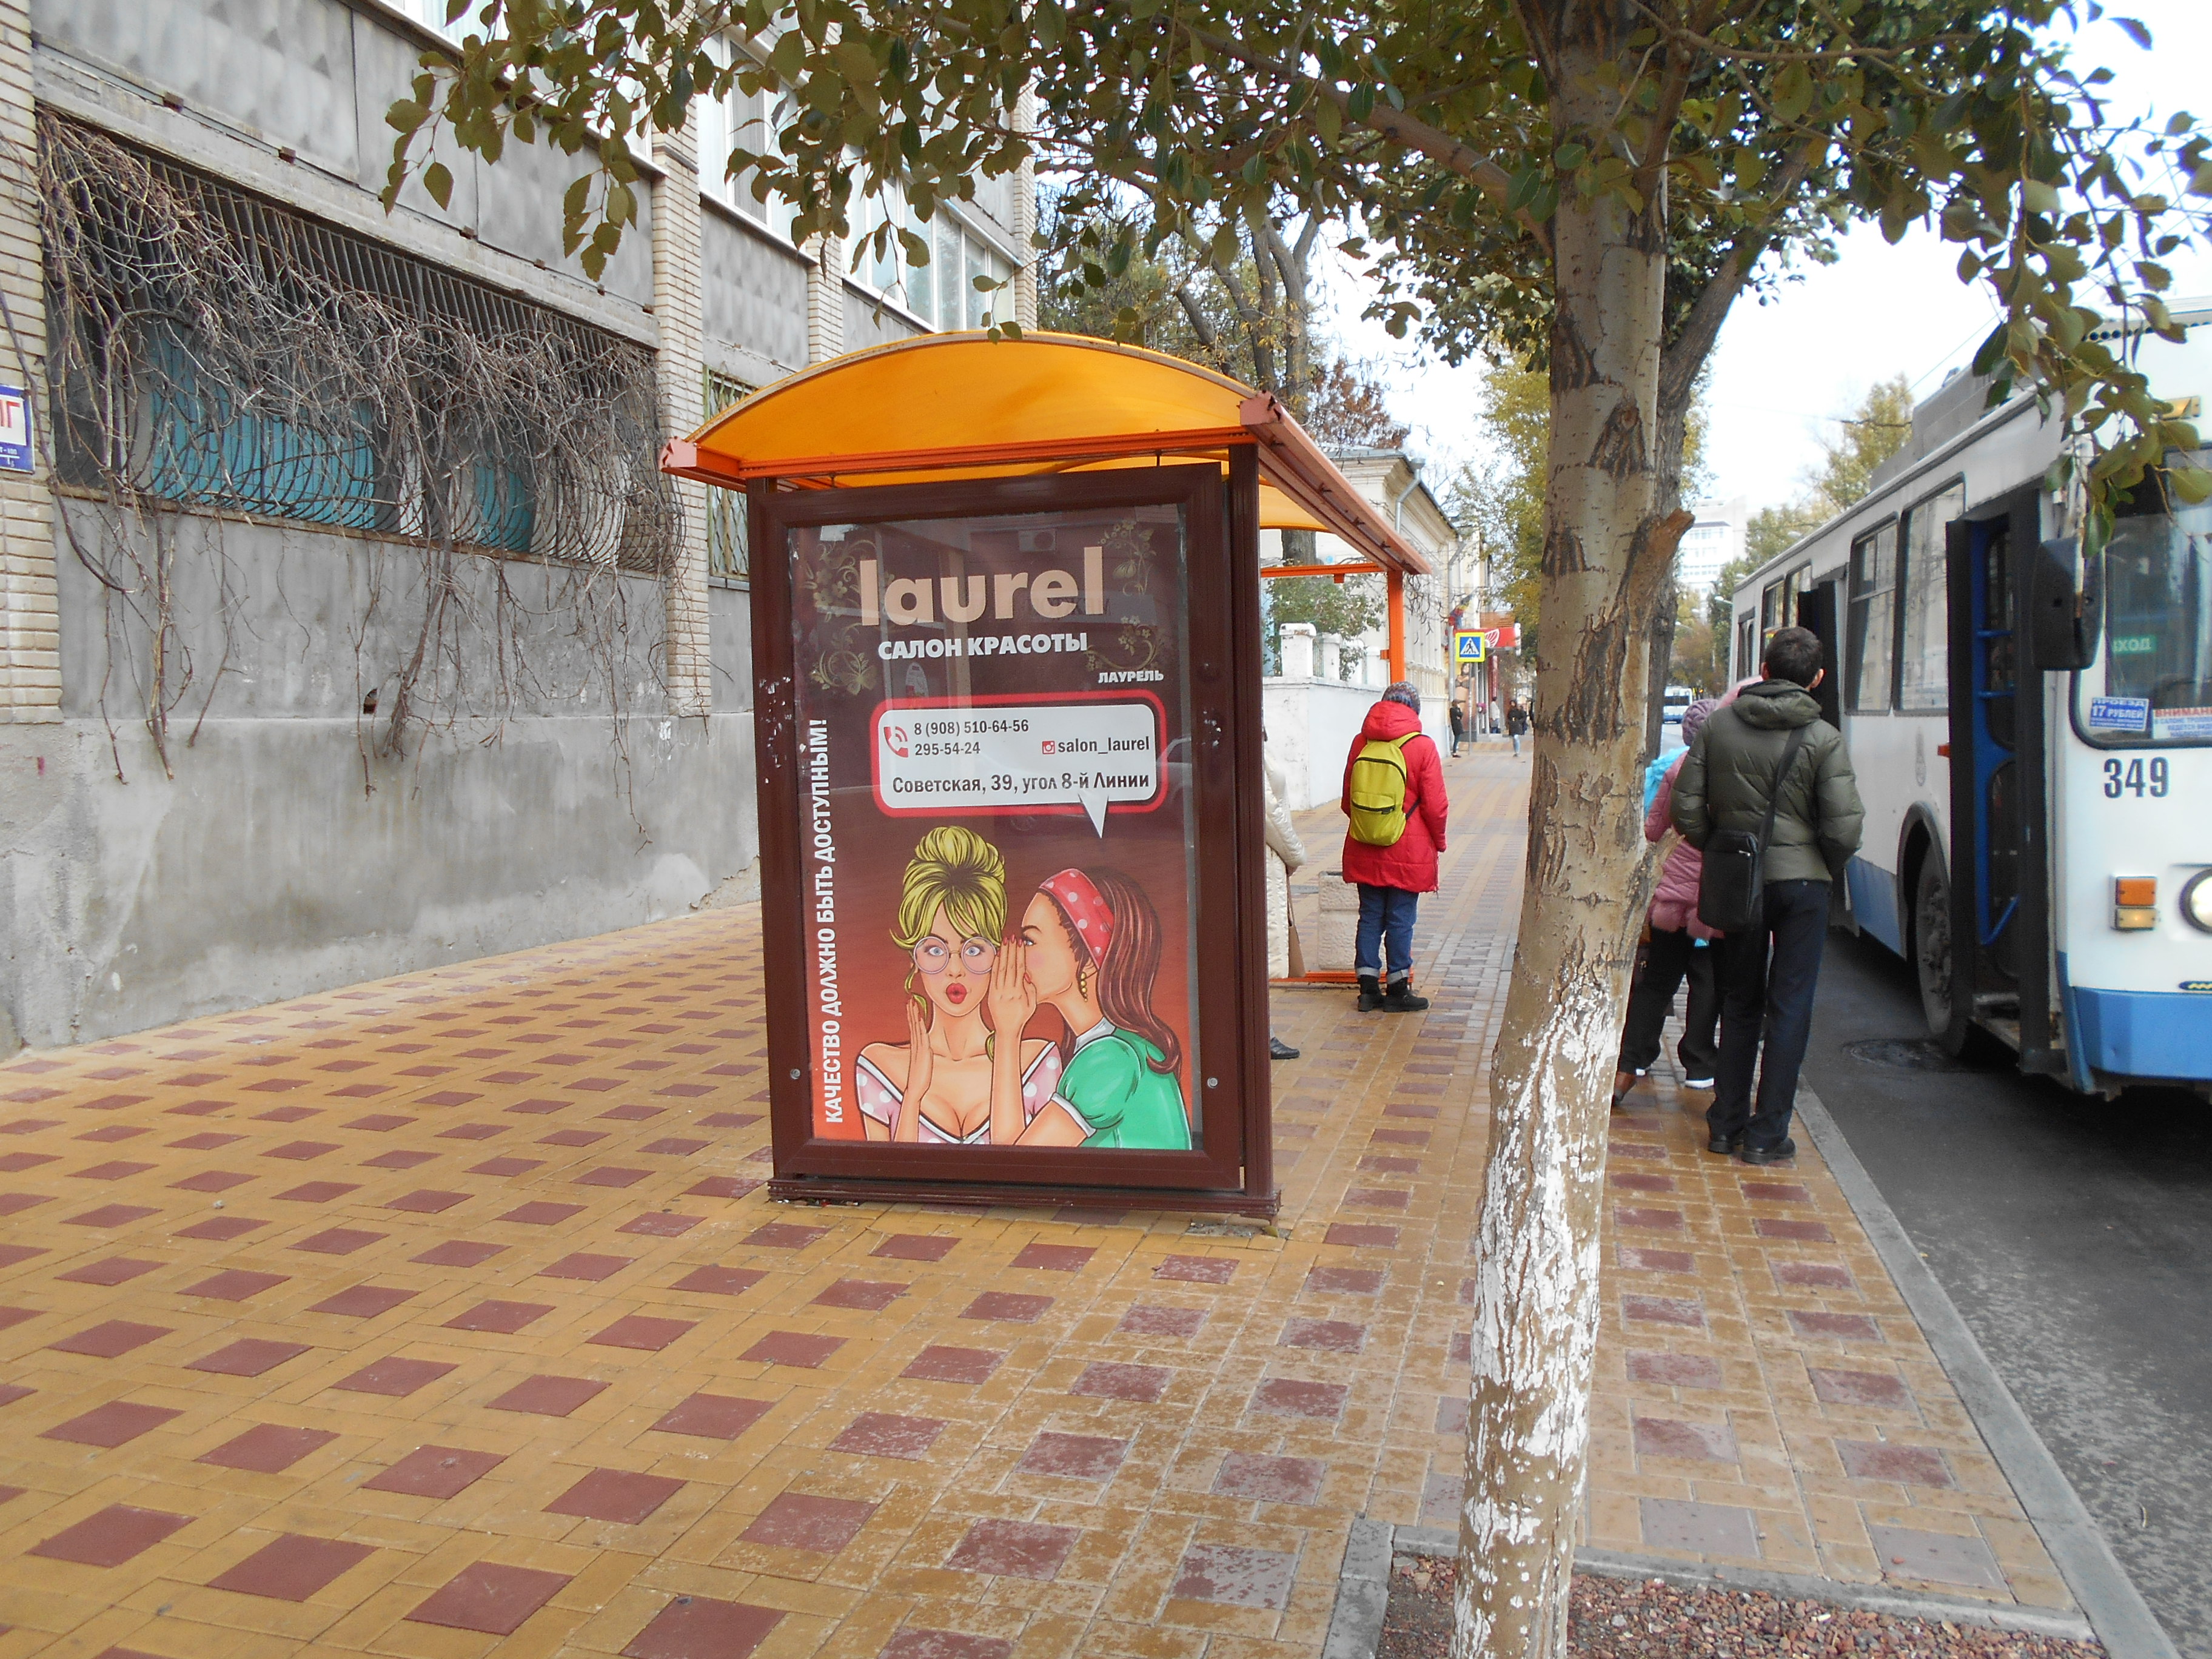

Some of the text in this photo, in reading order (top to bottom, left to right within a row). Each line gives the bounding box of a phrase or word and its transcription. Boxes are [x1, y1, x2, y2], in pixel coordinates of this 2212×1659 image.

[860, 546, 1104, 626] laurel
[878, 632, 1087, 660] САЛОН КРАСОТЫ
[2113, 637, 2152, 652] ХОД
[1098, 670, 1164, 683] ЛАУРЕЛЬ
[2093, 698, 2145, 707] ПРОЕЗД
[2093, 705, 2143, 719] 17 РУБЛЕЙ
[914, 719, 1029, 737] 8 (908) 510-64-56
[915, 742, 980, 756] 295-54-24
[1058, 736, 1149, 754] salon_laurel
[893, 772, 1149, 794] Советская, 39, угол 8-й Линии
[2103, 757, 2169, 798] 349
[809, 719, 843, 1123] КАЧЕСТВО ДОЛЖНО БЫТЬ ДОСТУПНЫМ!
